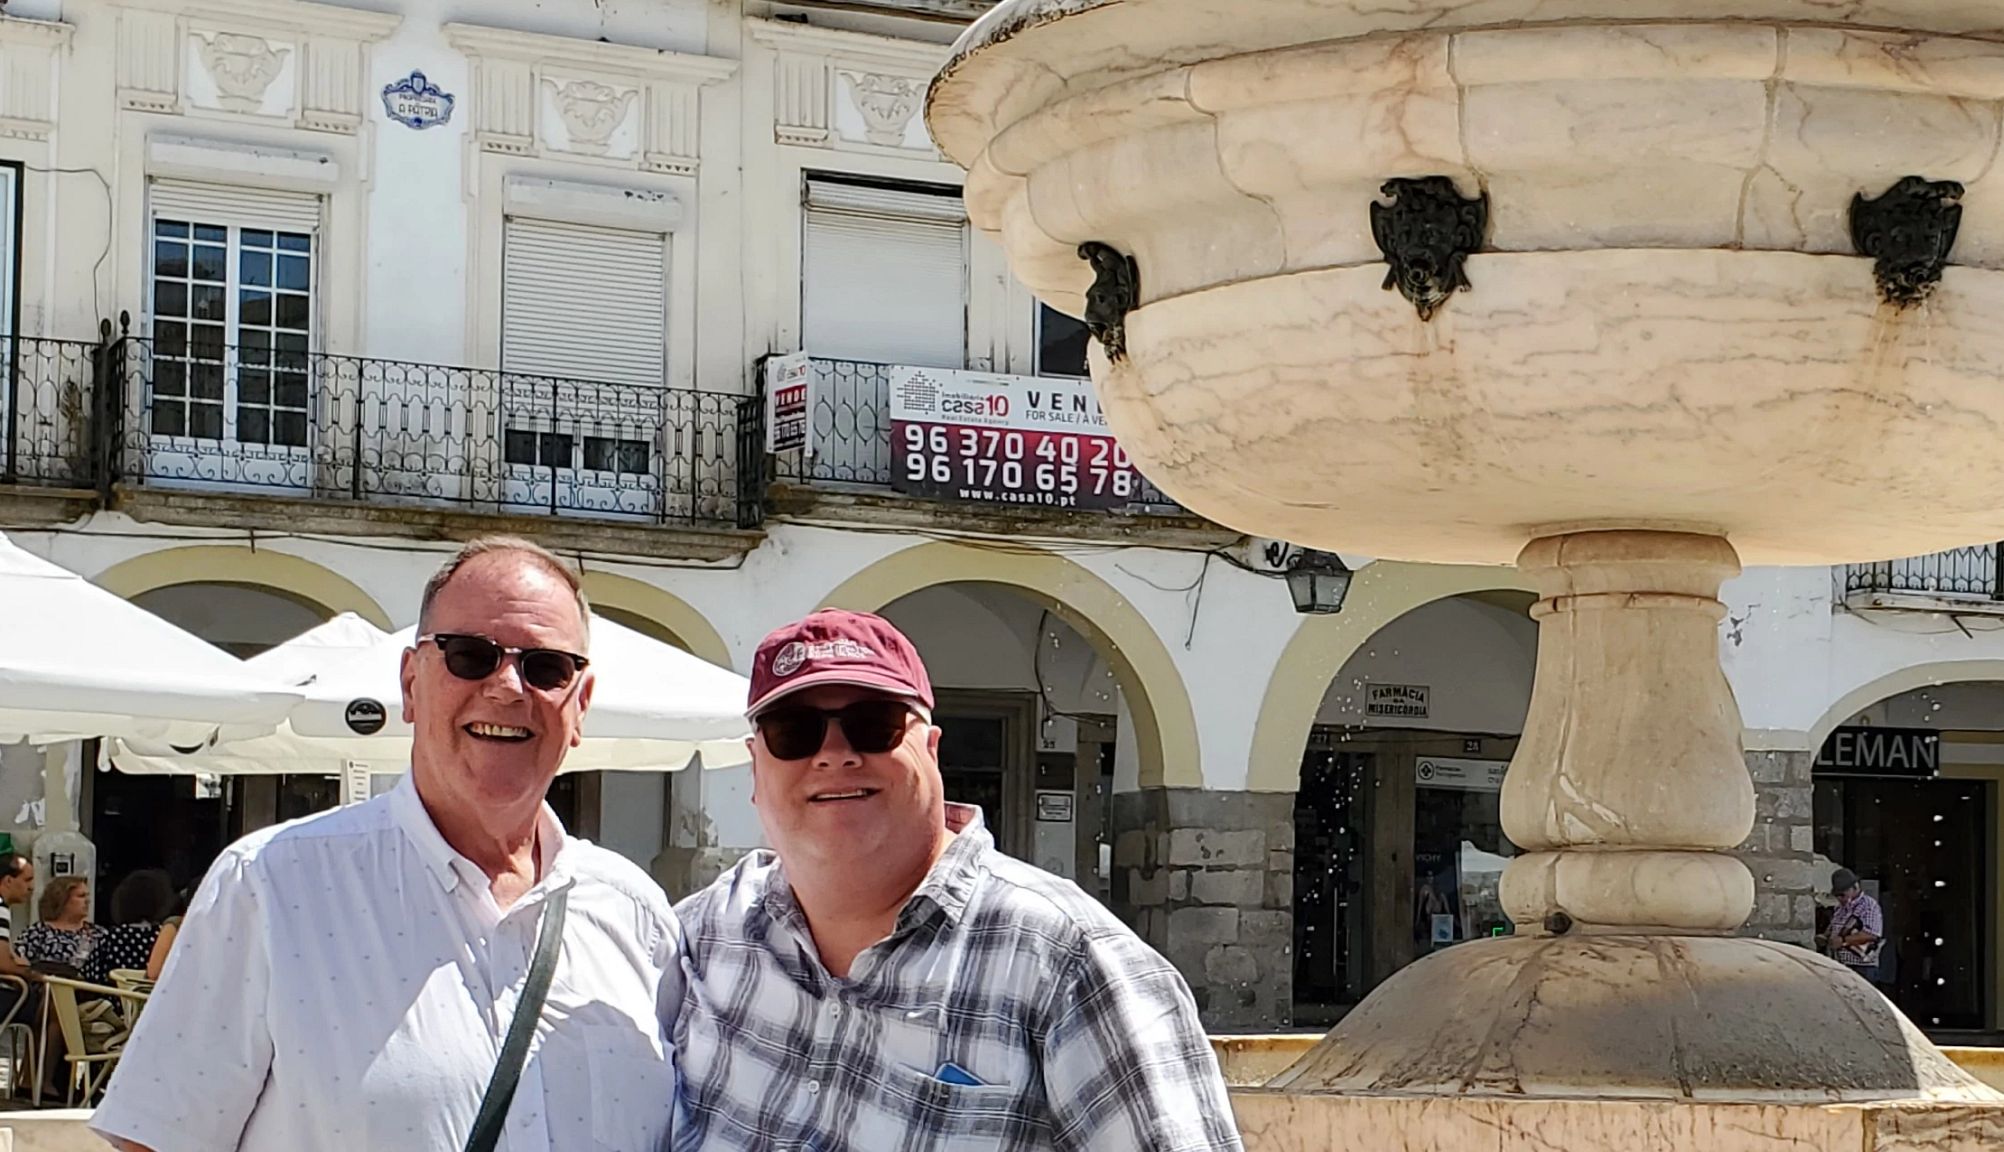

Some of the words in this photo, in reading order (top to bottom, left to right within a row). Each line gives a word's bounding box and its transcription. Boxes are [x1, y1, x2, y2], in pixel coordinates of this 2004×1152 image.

[941, 394, 1008, 417] casa10
[1026, 409, 1046, 421] FOR
[1048, 411, 1073, 423] SALE
[1091, 414, 1108, 426] VE
[905, 424, 948, 453] 96
[960, 429, 1023, 460] 370
[1036, 435, 1079, 464] 40
[1090, 438, 1132, 468] 20
[906, 453, 951, 482] 96
[963, 458, 1022, 488] 170
[1036, 464, 1078, 493] 65
[1089, 467, 1132, 496] 78
[960, 488, 1076, 506] www.casa10.pt
[1372, 686, 1425, 703] FARMÁCIA
